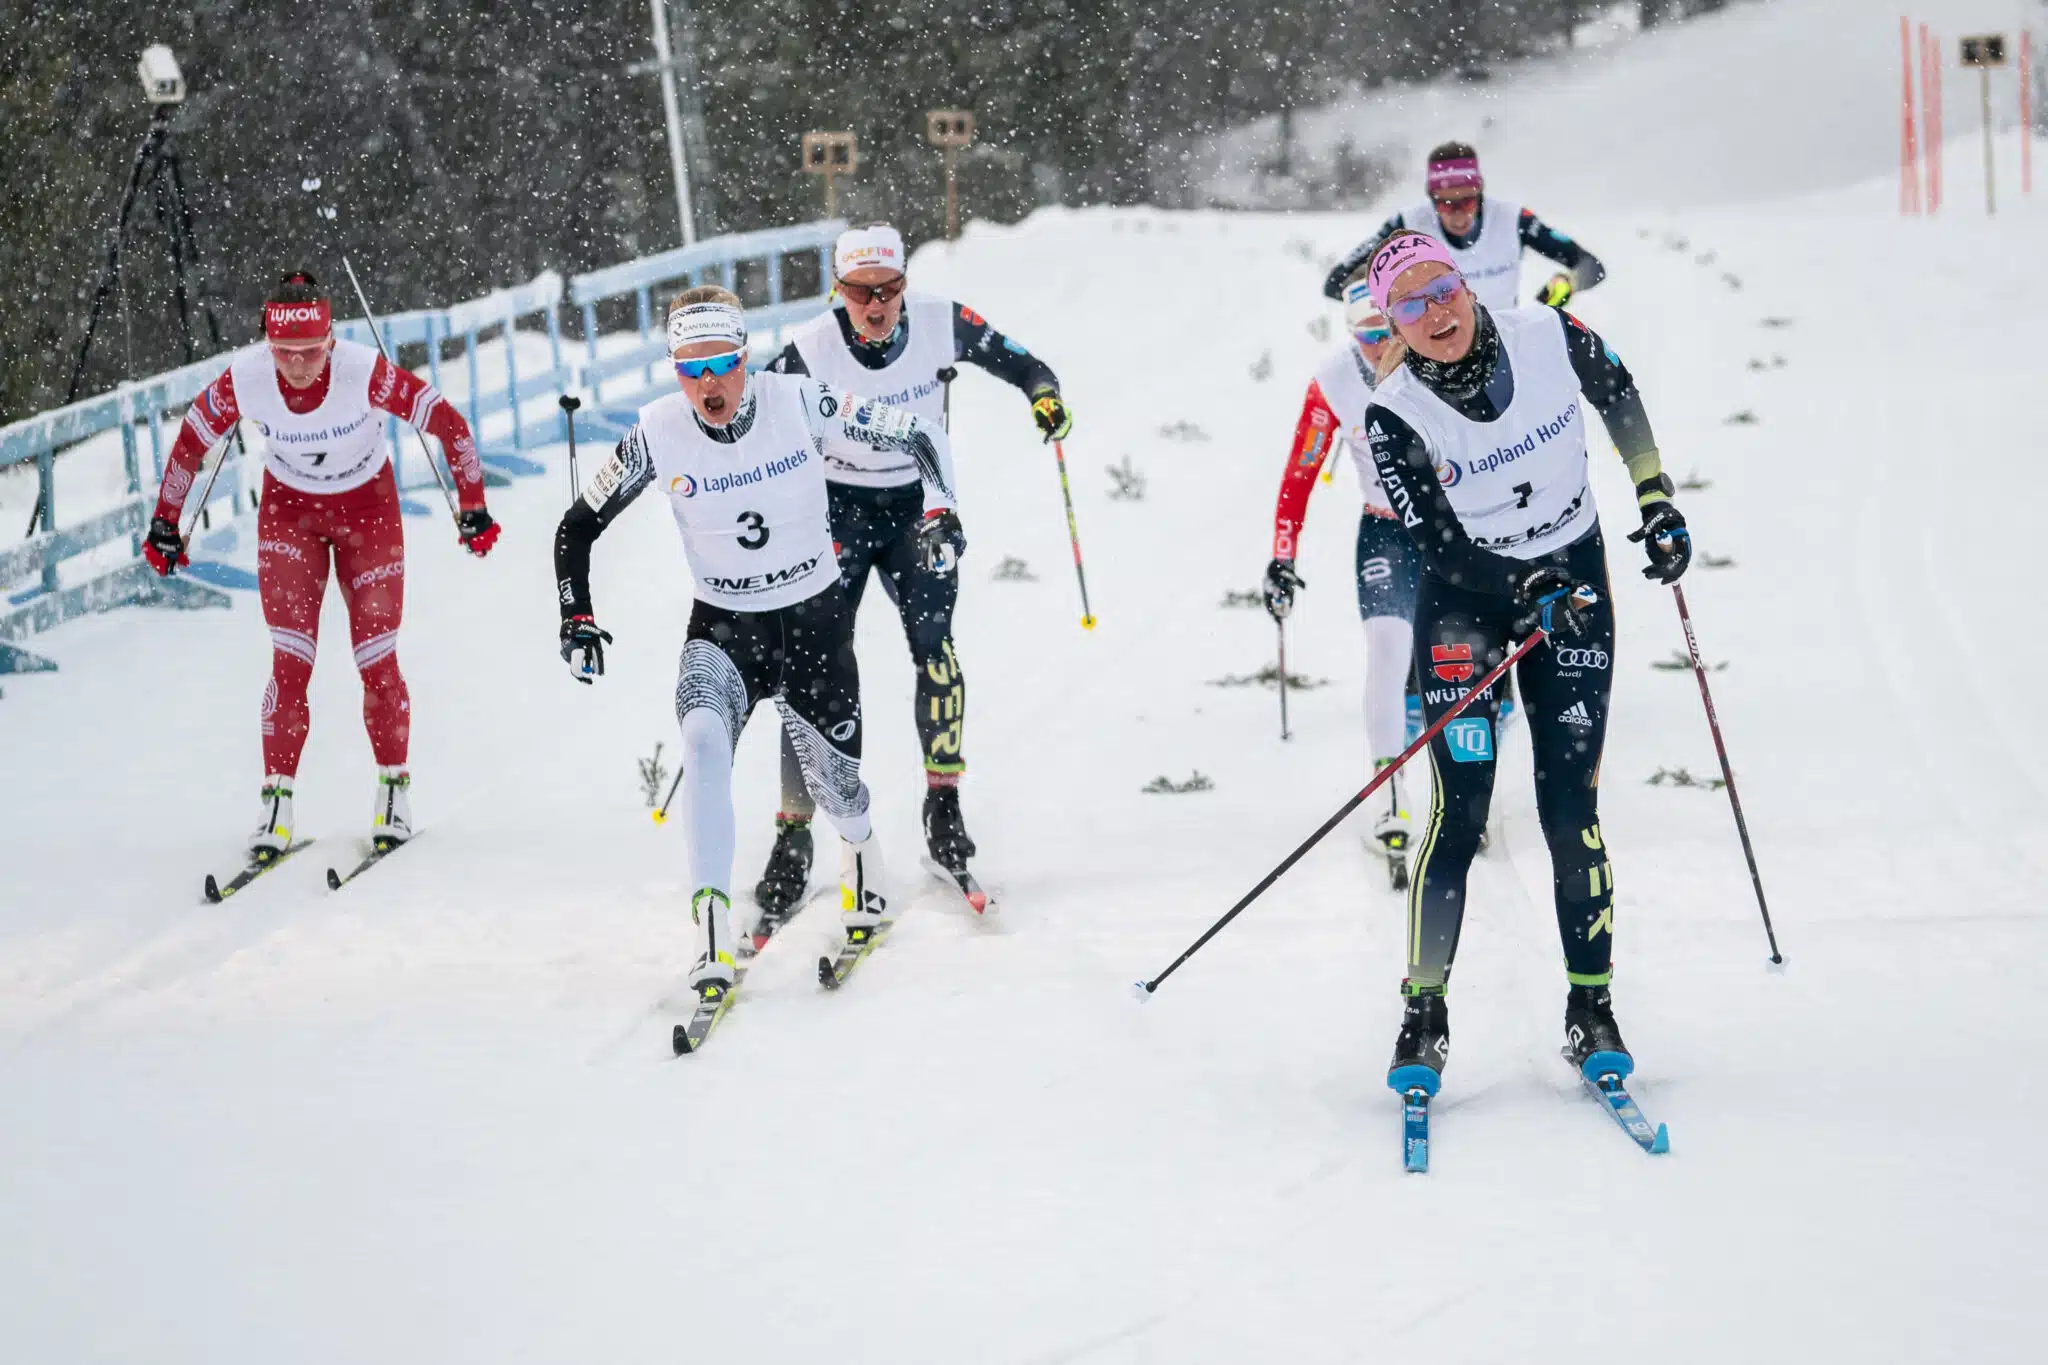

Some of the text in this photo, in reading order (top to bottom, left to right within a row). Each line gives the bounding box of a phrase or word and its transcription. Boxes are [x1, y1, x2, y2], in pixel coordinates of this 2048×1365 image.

[1373, 237, 1433, 286] JOKA
[270, 307, 321, 322] LUKOIL
[374, 361, 396, 403] LUKO
[878, 389, 909, 405] land
[276, 429, 328, 444] Lapland
[301, 451, 328, 466] 7
[703, 466, 763, 493] Lapland
[765, 448, 808, 478] Hotels
[1468, 434, 1535, 475] Lapland
[1381, 466, 1424, 529] Audi
[736, 510, 770, 550] 3
[259, 539, 302, 561] UKOIL
[1556, 670, 1582, 679] Audi
[927, 639, 965, 756] GER
[1558, 714, 1593, 727] adidas
[1450, 723, 1488, 756] TQ
